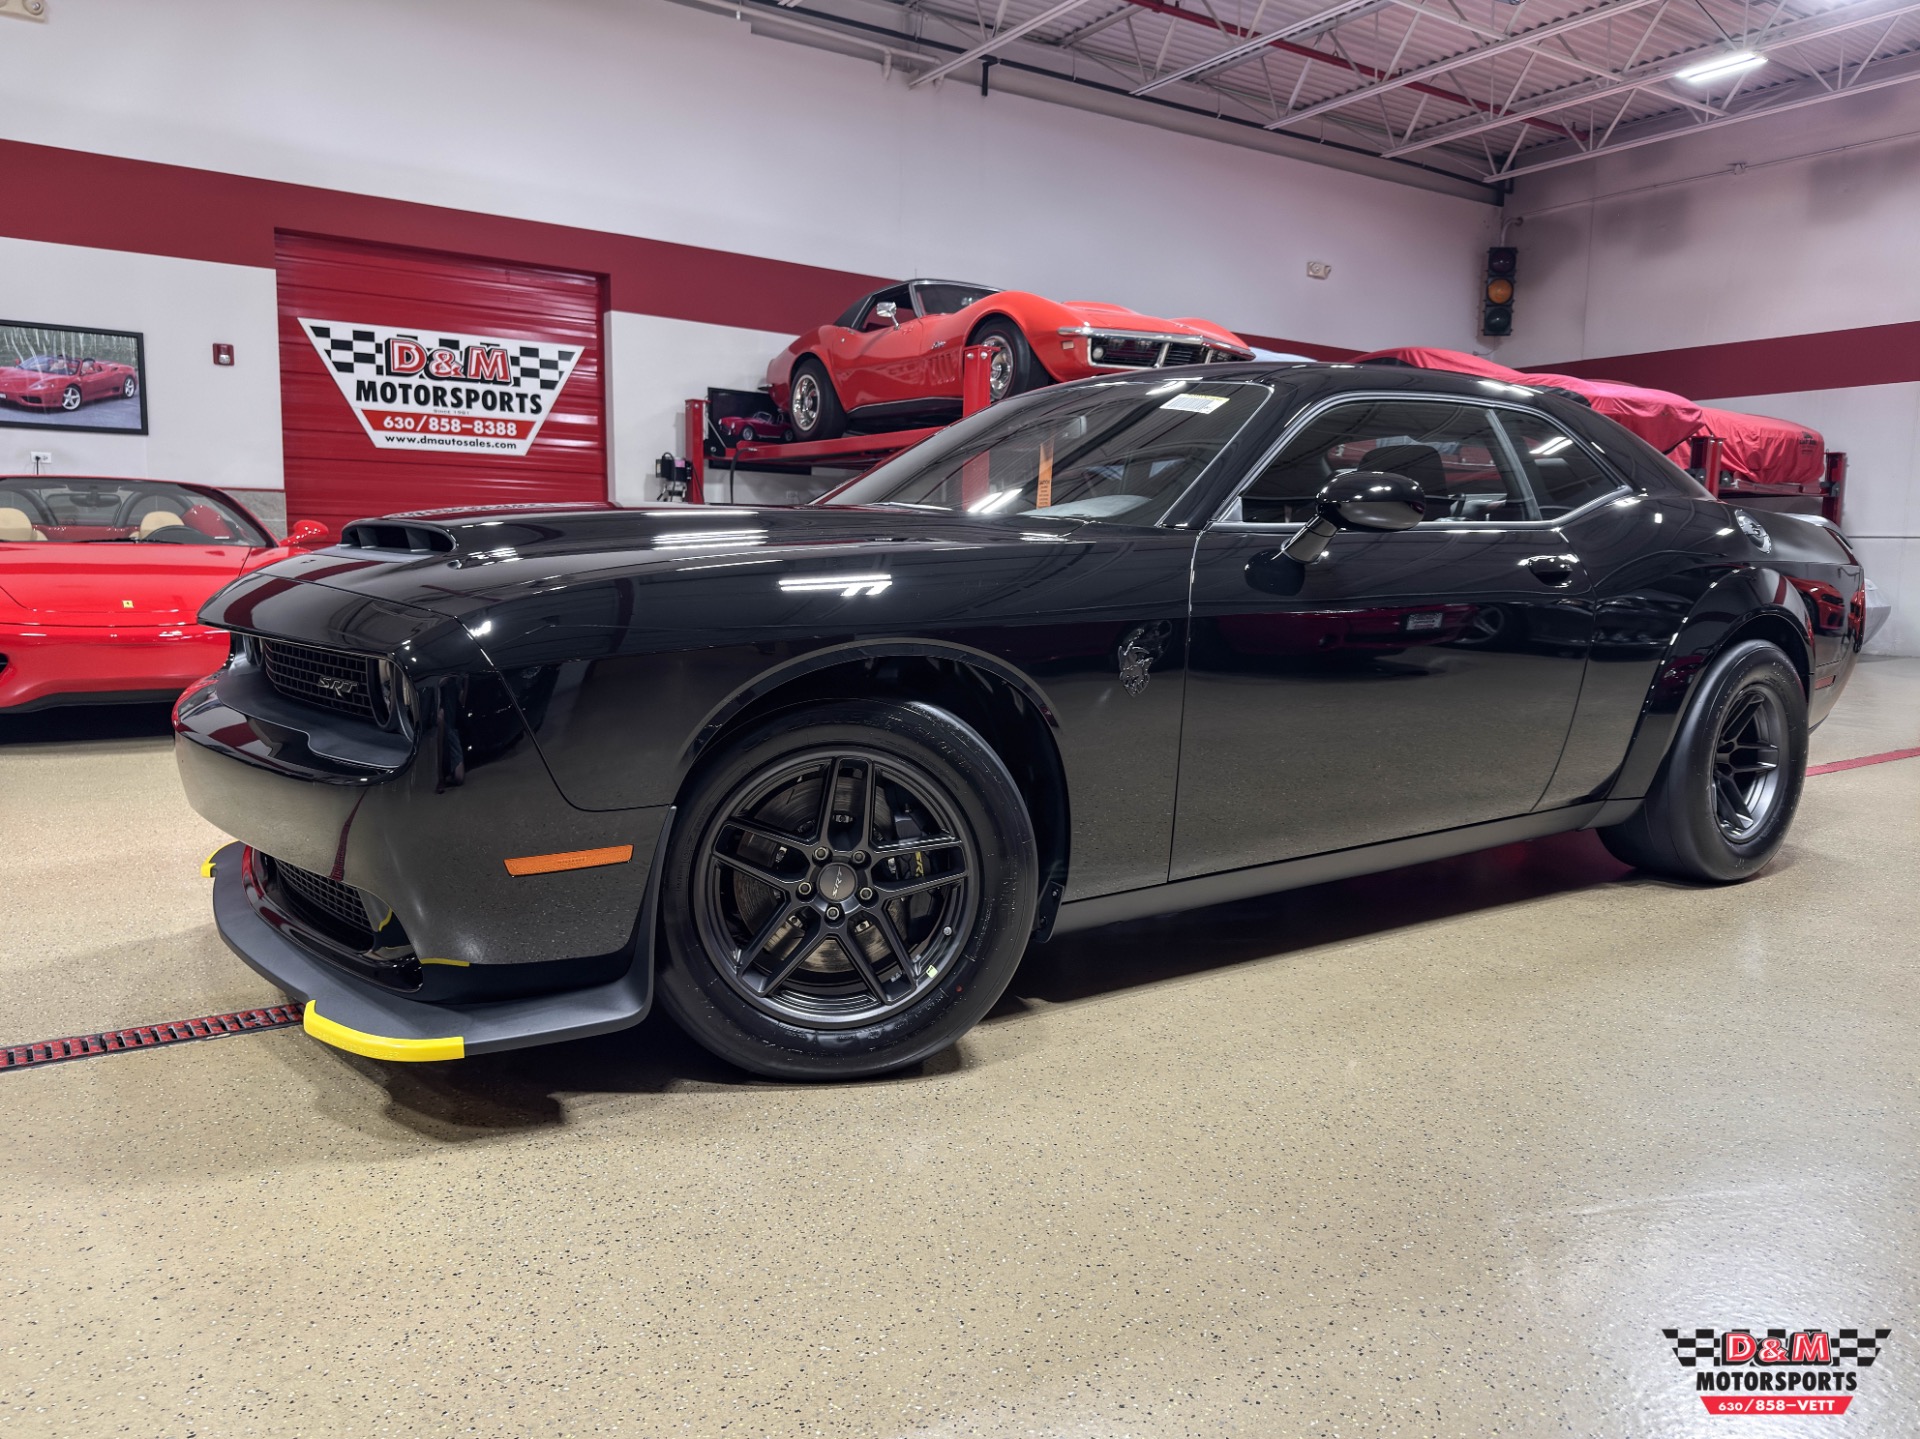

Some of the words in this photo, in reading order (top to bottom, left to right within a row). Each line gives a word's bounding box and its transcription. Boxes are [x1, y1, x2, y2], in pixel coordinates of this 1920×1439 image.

[385, 338, 512, 386] D&M
[355, 380, 542, 415] MOTORSPORTS
[383, 415, 517, 437] 630/858-8388
[385, 434, 517, 450] www.dmautosales.com
[319, 676, 358, 698] SRT
[832, 866, 842, 898] SRT
